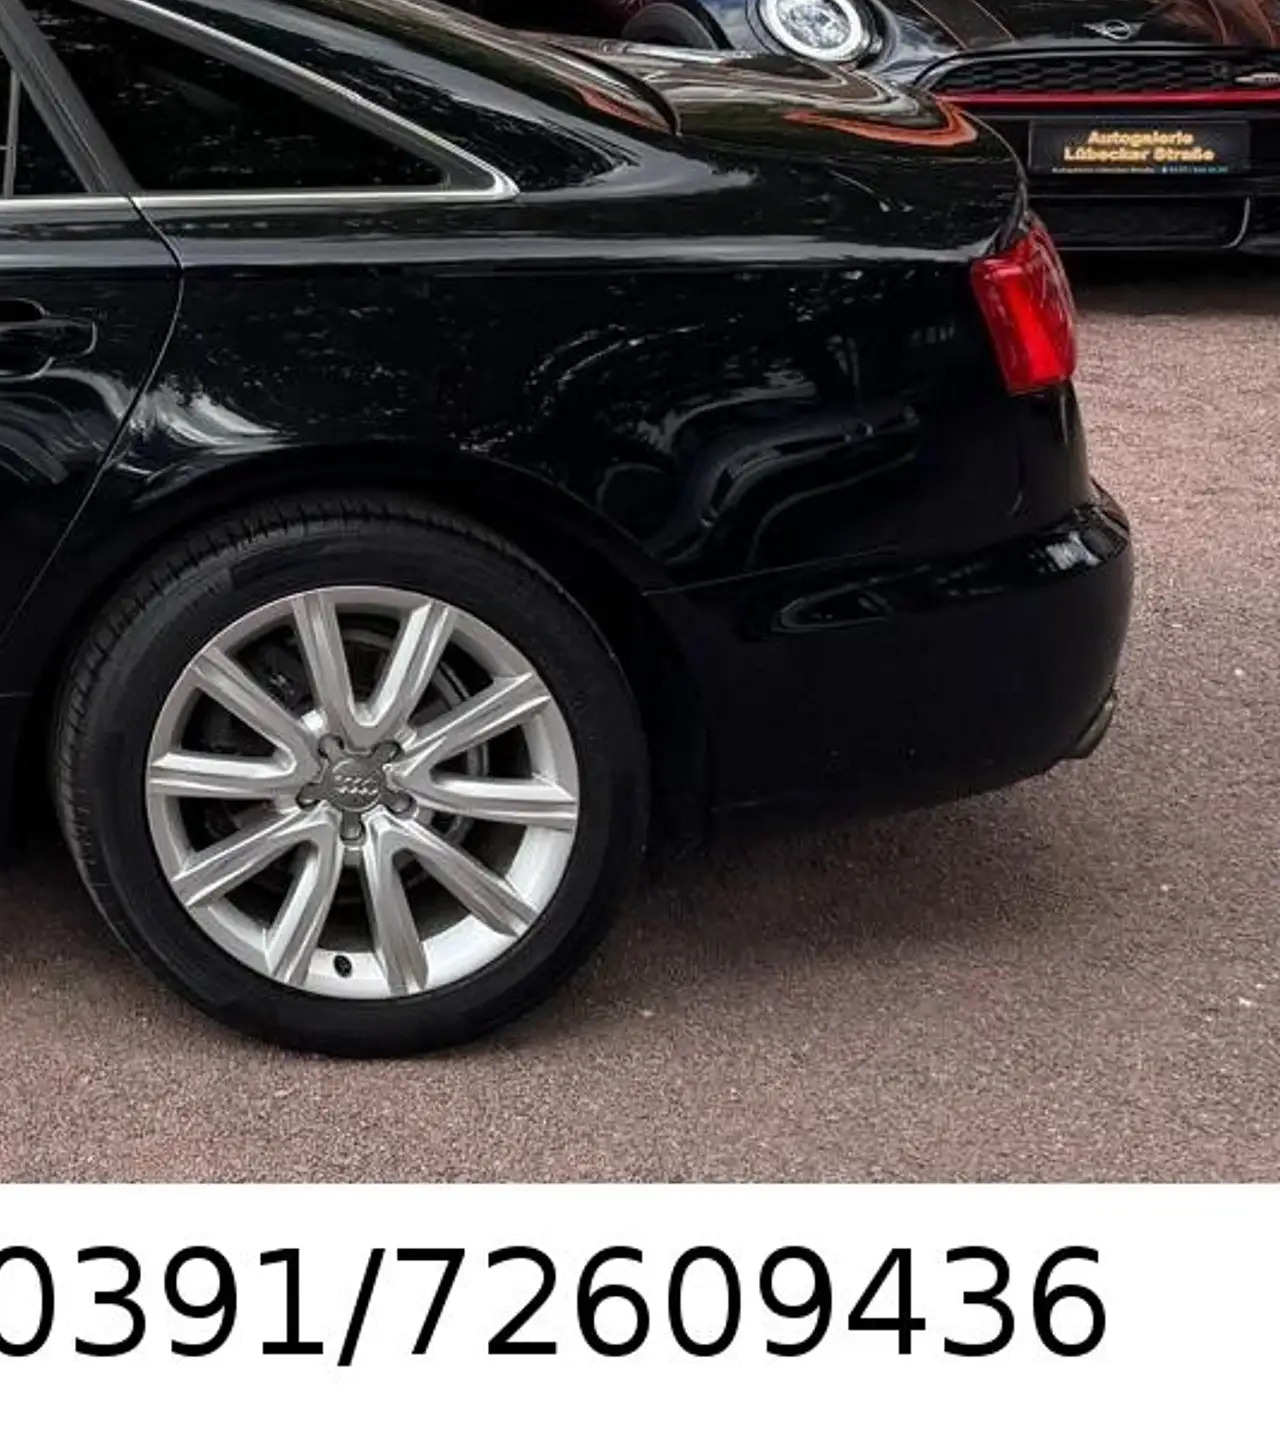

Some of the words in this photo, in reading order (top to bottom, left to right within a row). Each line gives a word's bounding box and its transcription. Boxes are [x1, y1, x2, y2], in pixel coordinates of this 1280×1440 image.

[1087, 130, 1194, 148] Autogalerie
[1063, 146, 1150, 162] Lübecker
[1153, 146, 1216, 162] Straße
